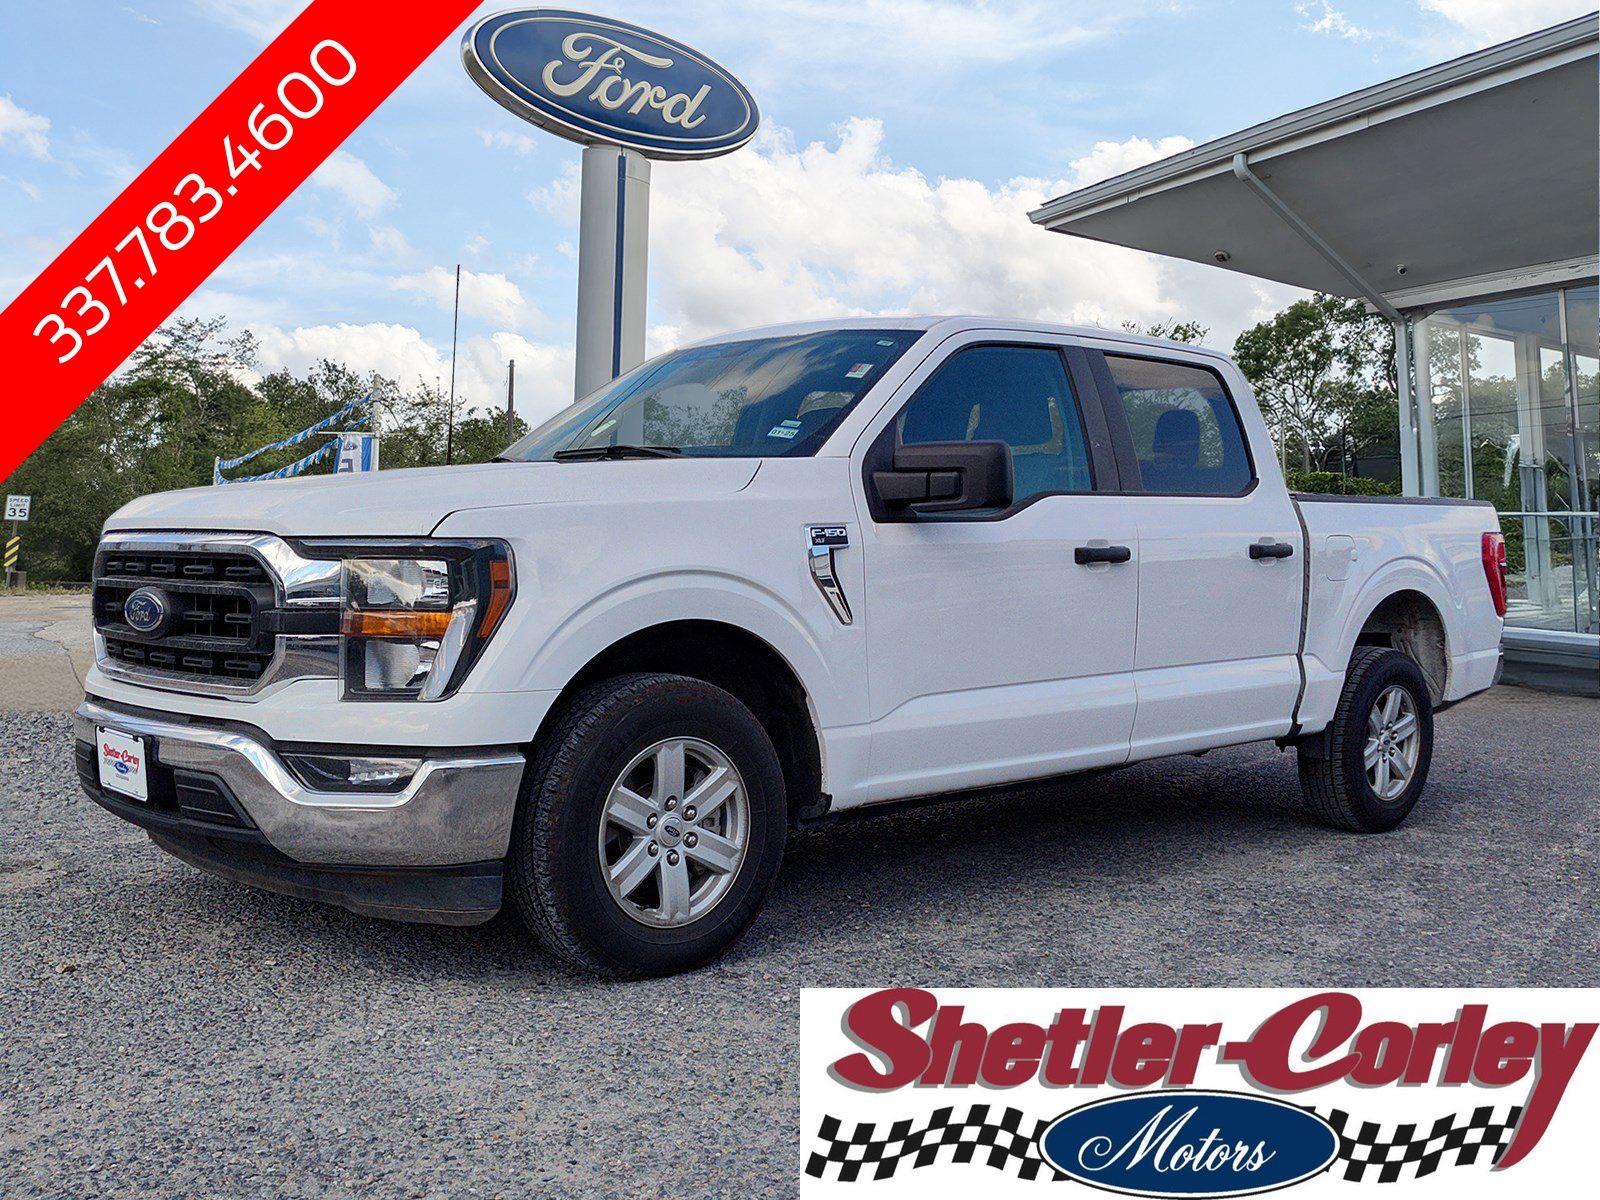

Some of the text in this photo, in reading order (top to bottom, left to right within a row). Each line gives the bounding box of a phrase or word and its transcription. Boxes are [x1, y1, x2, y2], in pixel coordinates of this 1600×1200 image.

[542, 33, 711, 129] Ford
[8, 507, 27, 517] 35
[811, 528, 847, 537] F-150
[130, 599, 152, 622] Ford
